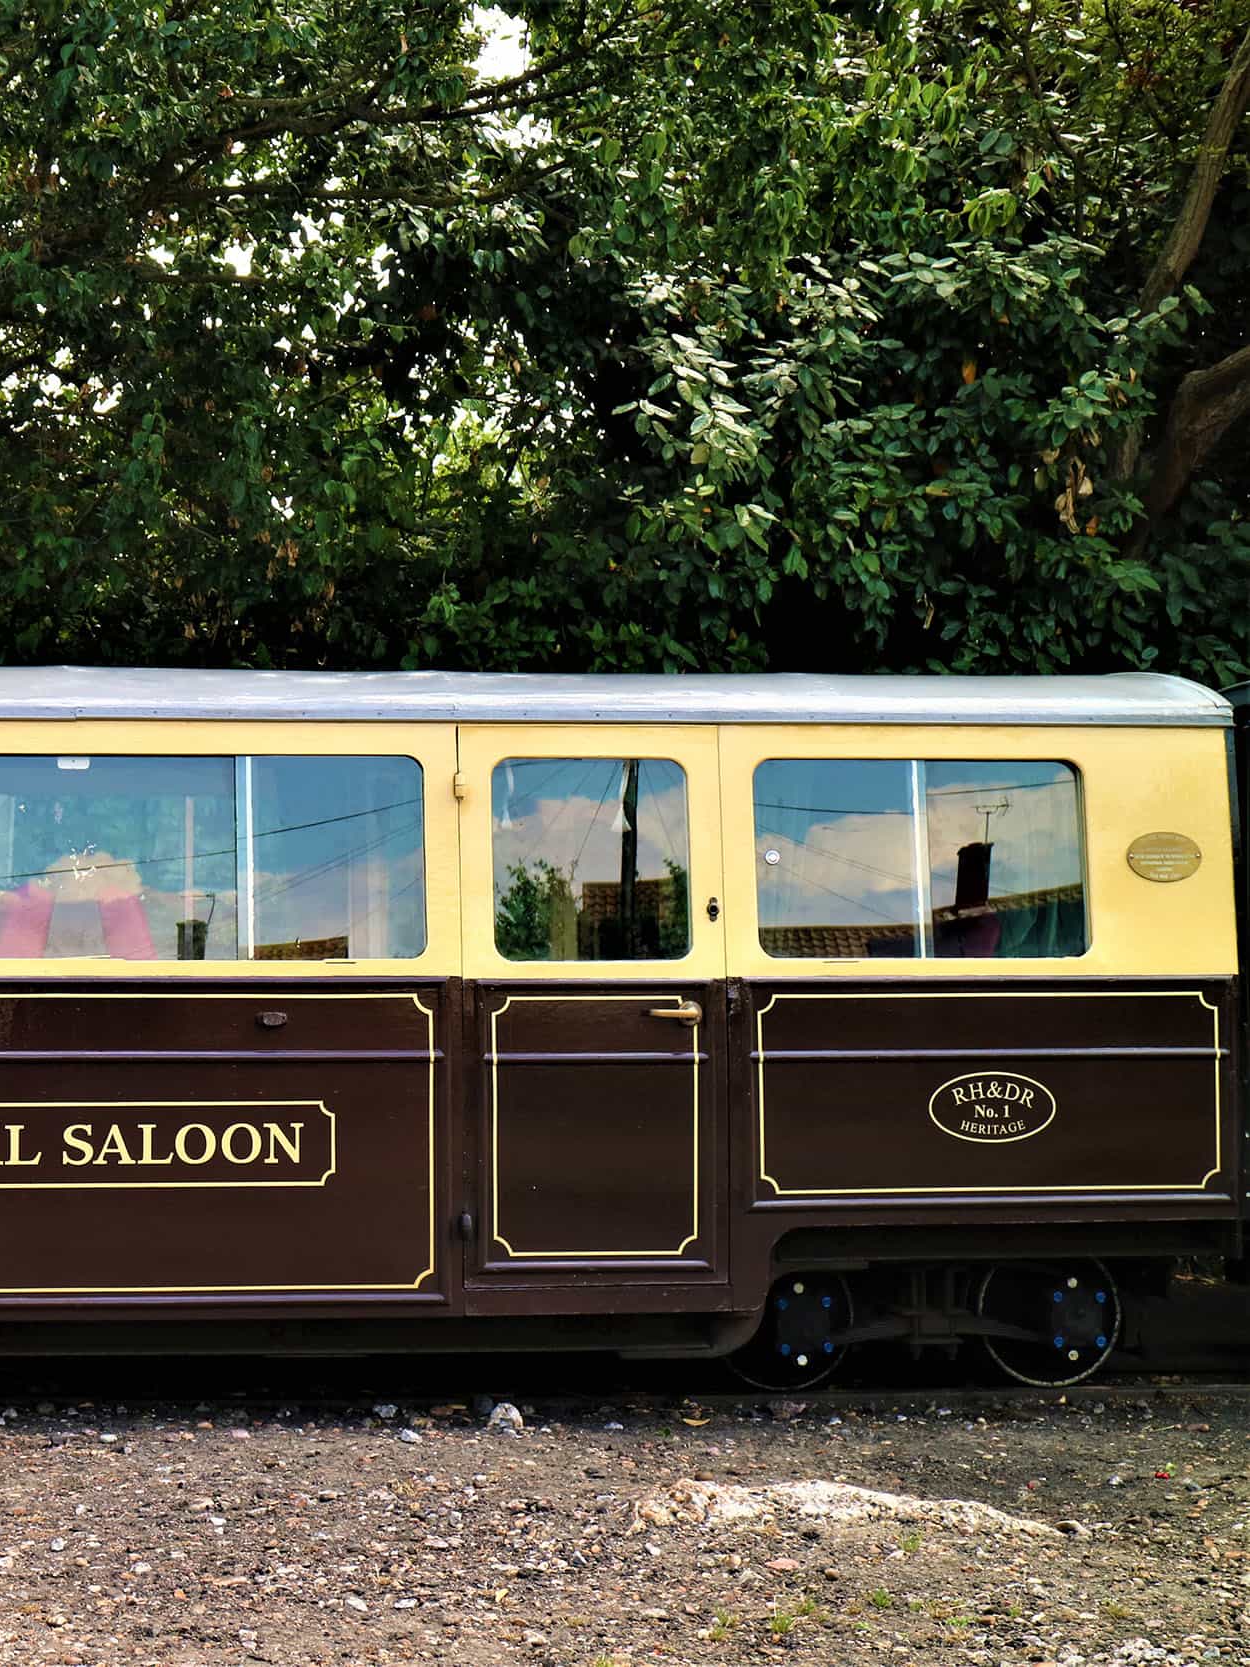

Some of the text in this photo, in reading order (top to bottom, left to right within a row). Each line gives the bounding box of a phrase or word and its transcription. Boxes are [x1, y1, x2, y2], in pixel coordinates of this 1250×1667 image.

[952, 1081, 1035, 1109] RH&DR
[973, 1104, 1011, 1118] No. 1
[960, 1119, 1026, 1135] HERITAGE
[61, 1122, 304, 1166] SALOON
